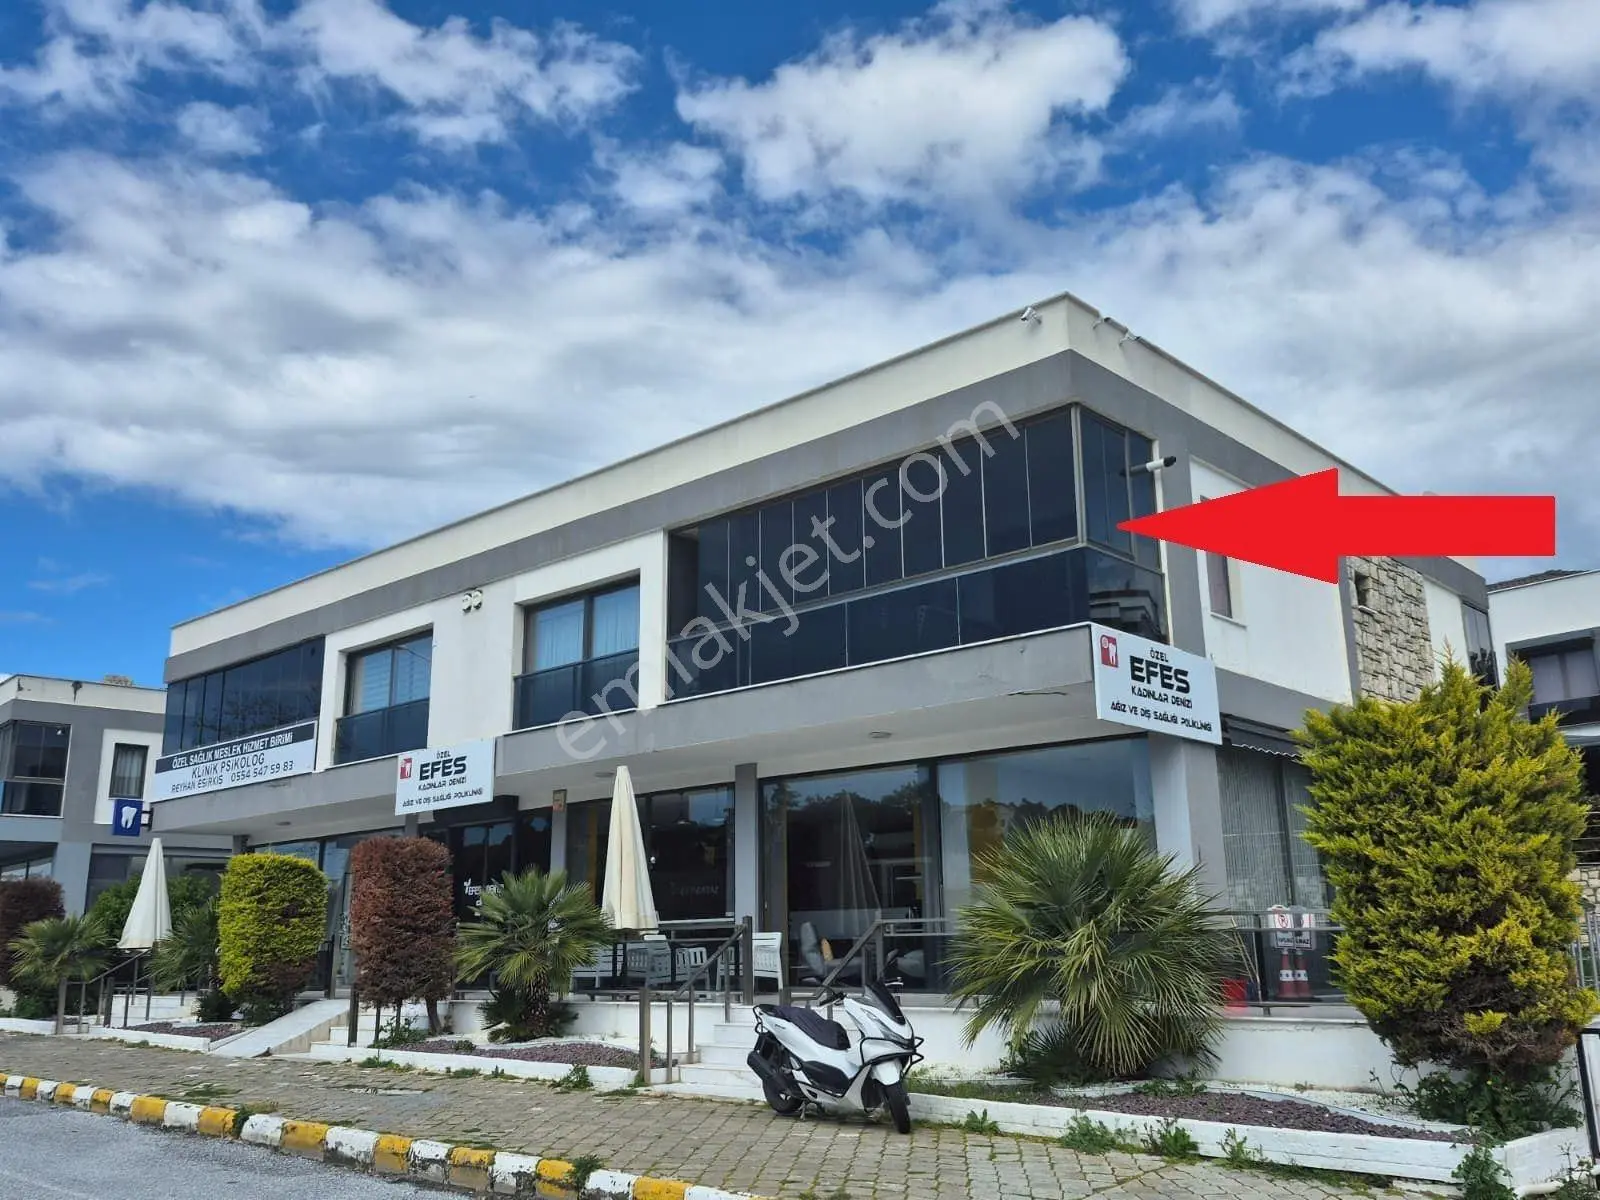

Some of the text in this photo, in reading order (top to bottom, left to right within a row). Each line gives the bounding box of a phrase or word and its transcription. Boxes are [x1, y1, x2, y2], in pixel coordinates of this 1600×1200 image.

[1149, 647, 1169, 663] ÖZEL
[1129, 655, 1191, 694] EFES
[1131, 685, 1169, 704] KADINLAR
[1128, 704, 1139, 716] VE
[171, 732, 293, 770] ÖZEL SAĞLIK MESLEK HİZMET BİRİMİ
[191, 752, 265, 779] KLİNİK PSİKOLOG
[231, 770, 251, 783] 0554
[253, 765, 269, 778] 547
[270, 762, 281, 774] 59
[283, 760, 294, 772] 83
[419, 756, 467, 781] EFES
